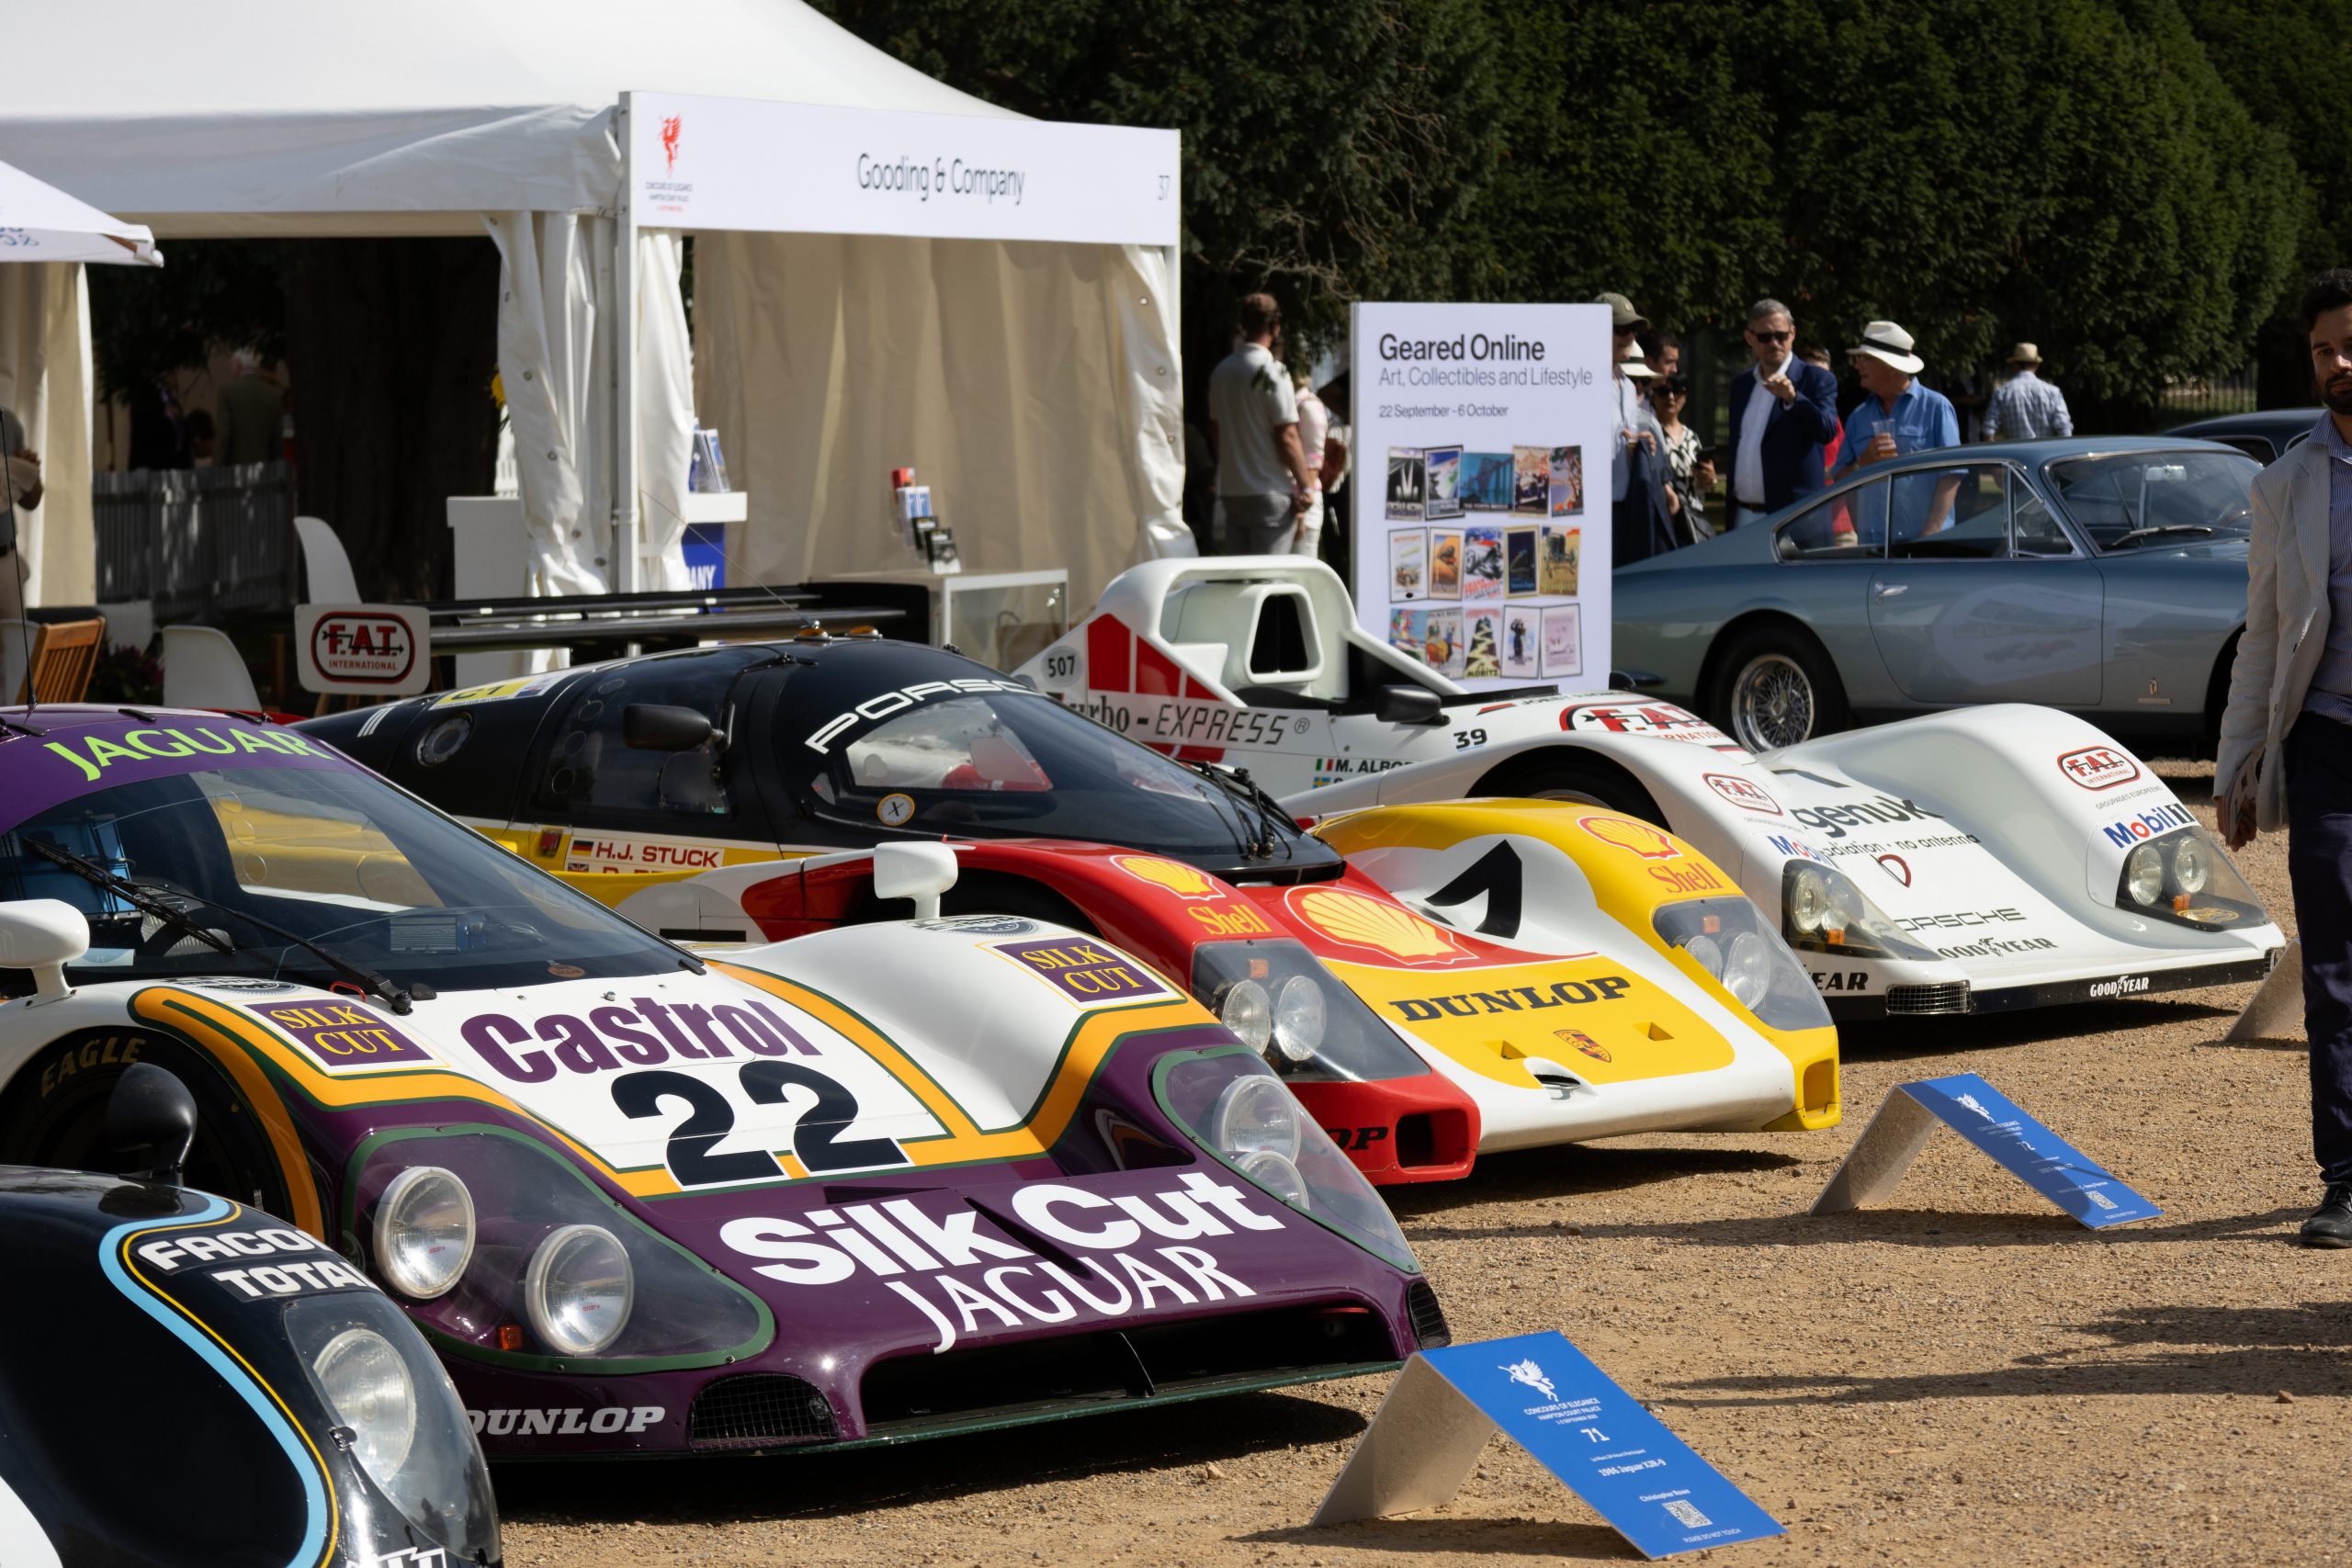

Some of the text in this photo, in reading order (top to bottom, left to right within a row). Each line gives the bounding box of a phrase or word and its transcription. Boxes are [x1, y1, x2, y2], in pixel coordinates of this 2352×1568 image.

[858, 152, 1025, 205] Gooding & Company
[1157, 175, 1170, 201] 37
[1379, 333, 1545, 360] Geared Online
[1379, 367, 1592, 389] Art, Collectibles and Lifestyle
[1379, 405, 1393, 418] 22
[1394, 404, 1450, 419] September
[1458, 404, 1464, 417] 6
[1466, 404, 1508, 417] October
[329, 660, 398, 671] INTERNATIONAL
[1048, 655, 1076, 678] 507
[1155, 704, 1289, 745] EXPRESS
[1453, 728, 1487, 750] 39
[43, 727, 336, 782] JAGUAR
[1336, 759, 1353, 773] M.
[2087, 768, 2131, 784] INTERNATIONAL
[2103, 807, 2177, 849] Mobil
[596, 841, 720, 868] H.J. STUCK
[1895, 840, 1917, 851] no
[1917, 834, 1981, 848] antenna
[1425, 839, 1522, 940] 1
[1648, 863, 1725, 894] Shell
[1188, 904, 1272, 936] Shell
[1021, 944, 1116, 970] SILK
[1064, 966, 1143, 994] CUT
[1388, 976, 1631, 1022] DUNLOP
[269, 1006, 379, 1031] SILK
[314, 1028, 404, 1056] CUT
[460, 997, 822, 1084] Castrol
[40, 1037, 147, 1099] EAGLE
[610, 1060, 910, 1187] 22
[719, 1172, 1286, 1285] Silk Cut
[884, 1246, 1258, 1355] JAGUAR
[1523, 1404, 1559, 1414] CONCOURS
[1567, 1398, 1600, 1406] ELEGANCE
[467, 1406, 665, 1435] DUNLOP
[1580, 1427, 1609, 1441] 71
[1617, 1463, 1645, 1473] Jaguar
